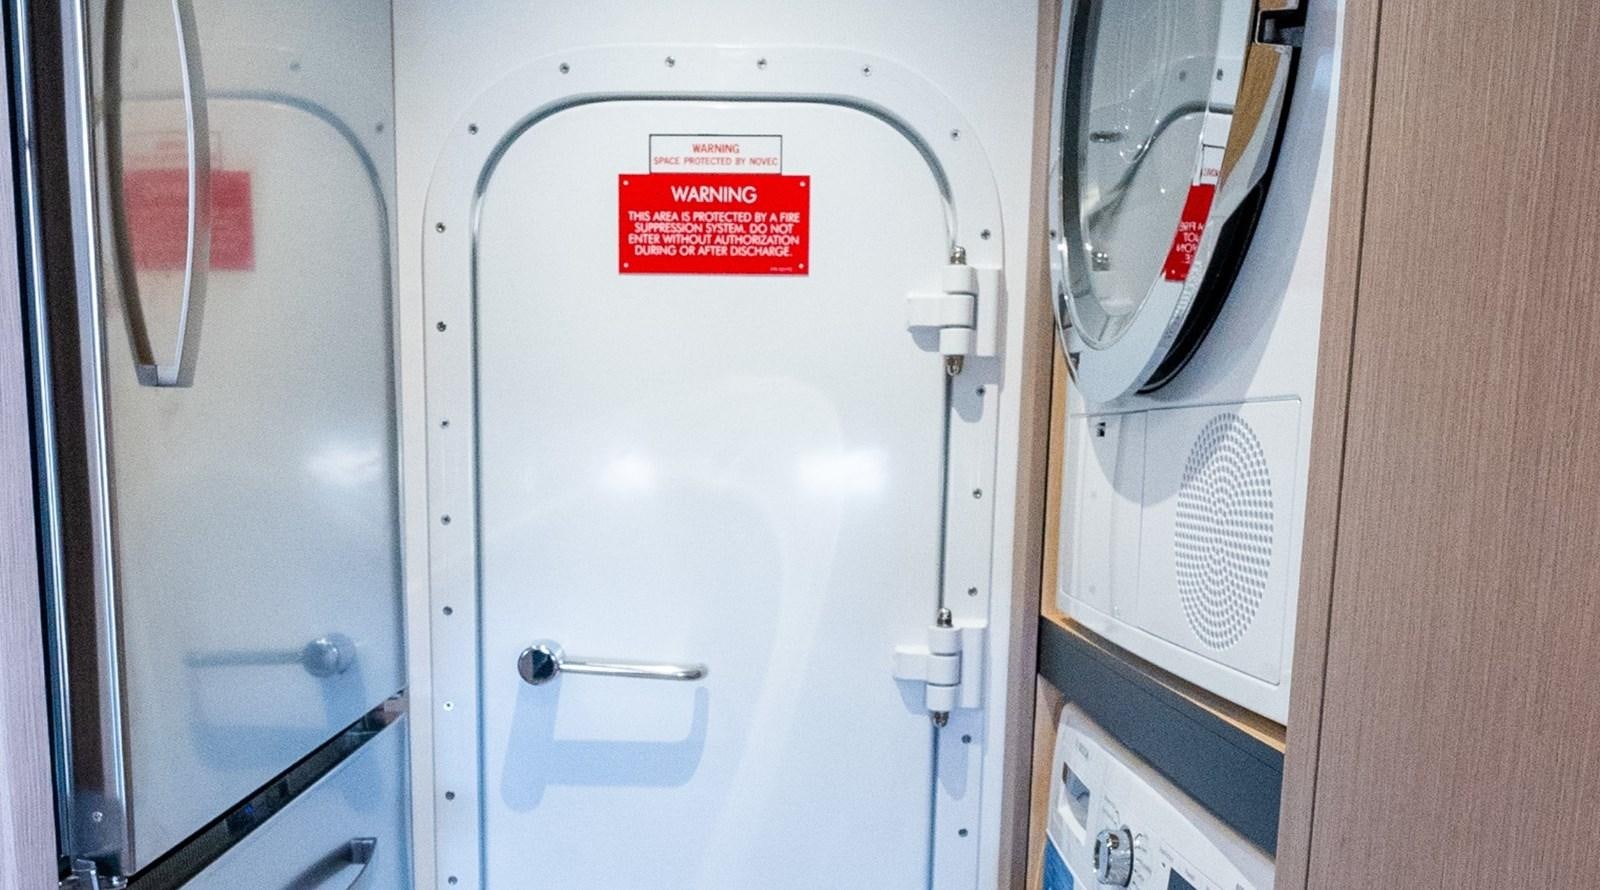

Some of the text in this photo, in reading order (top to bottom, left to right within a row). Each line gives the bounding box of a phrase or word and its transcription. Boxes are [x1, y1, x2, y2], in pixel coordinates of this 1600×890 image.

[692, 144, 740, 153] WARNING
[654, 157, 778, 166] SPACE PROTECTED BY NOVEC
[671, 186, 757, 203] WARNING
[628, 211, 800, 223] THIS AREA IS PROTECTED BY A FIRE
[635, 223, 794, 234] SUPPRESSION SYSTEM. DO NOT
[628, 234, 799, 245] ENTER WITHOUT AUTHORIZATION
[634, 245, 792, 257] DURING OR AFTER DISCHARGE.
